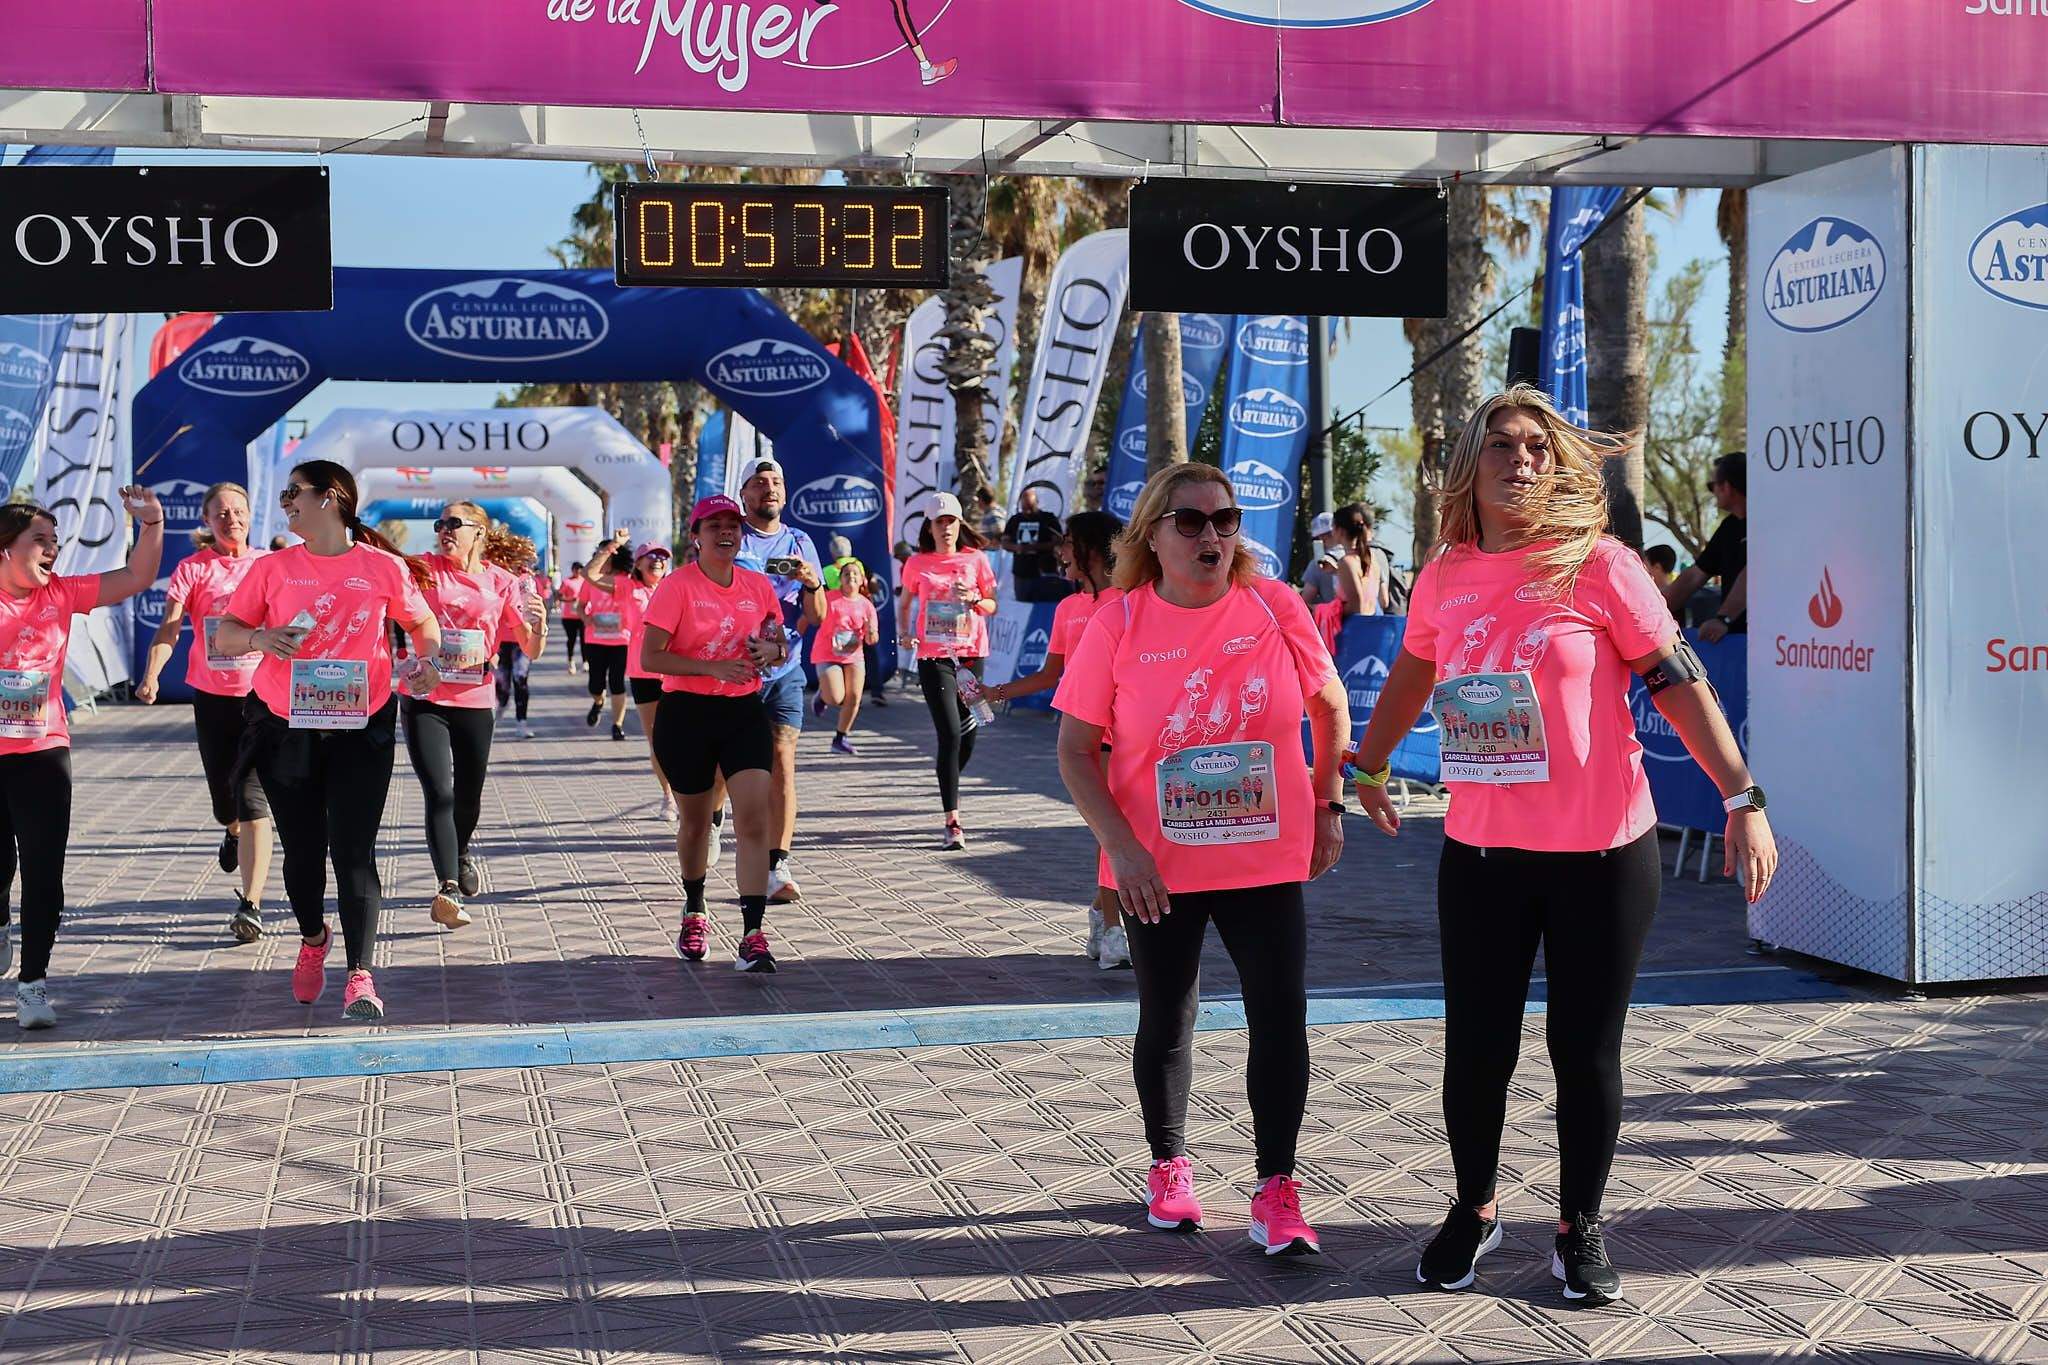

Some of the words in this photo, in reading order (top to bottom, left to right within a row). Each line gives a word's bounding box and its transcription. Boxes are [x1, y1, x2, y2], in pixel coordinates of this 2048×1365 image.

[546, 0, 596, 22] de
[634, 0, 840, 93] Mujer
[15, 213, 280, 267] OYSHO
[639, 200, 924, 269] 00:57:32
[1183, 223, 1403, 275] OYSHO
[1771, 263, 1876, 310] ASTURIANA
[452, 302, 516, 313] CENTRAL
[522, 302, 587, 314] LECHERA
[421, 303, 594, 341] ASTURIANA
[186, 358, 301, 382] ASTURIANA
[716, 362, 823, 384] ASTURIANA
[392, 420, 550, 452] OYSHO
[1764, 415, 1885, 472] OYSHO
[1139, 647, 1188, 664] OYSHO
[1775, 635, 1875, 672] Santander
[1, 699, 30, 712] 016
[316, 690, 346, 702] 016
[1468, 721, 1508, 740] 016
[1478, 744, 1497, 753] 2430
[1510, 753, 1540, 761] VALENCIA
[1193, 759, 1238, 770] ASTURIANA
[1448, 766, 1483, 776] OYSHO
[1196, 788, 1241, 807] 016
[1166, 820, 1194, 828] CARRERA
[1214, 818, 1237, 826] MUJER
[1241, 815, 1271, 825] VALENCIA
[1207, 810, 1228, 818] 2431
[1173, 831, 1209, 840] OYSHO
